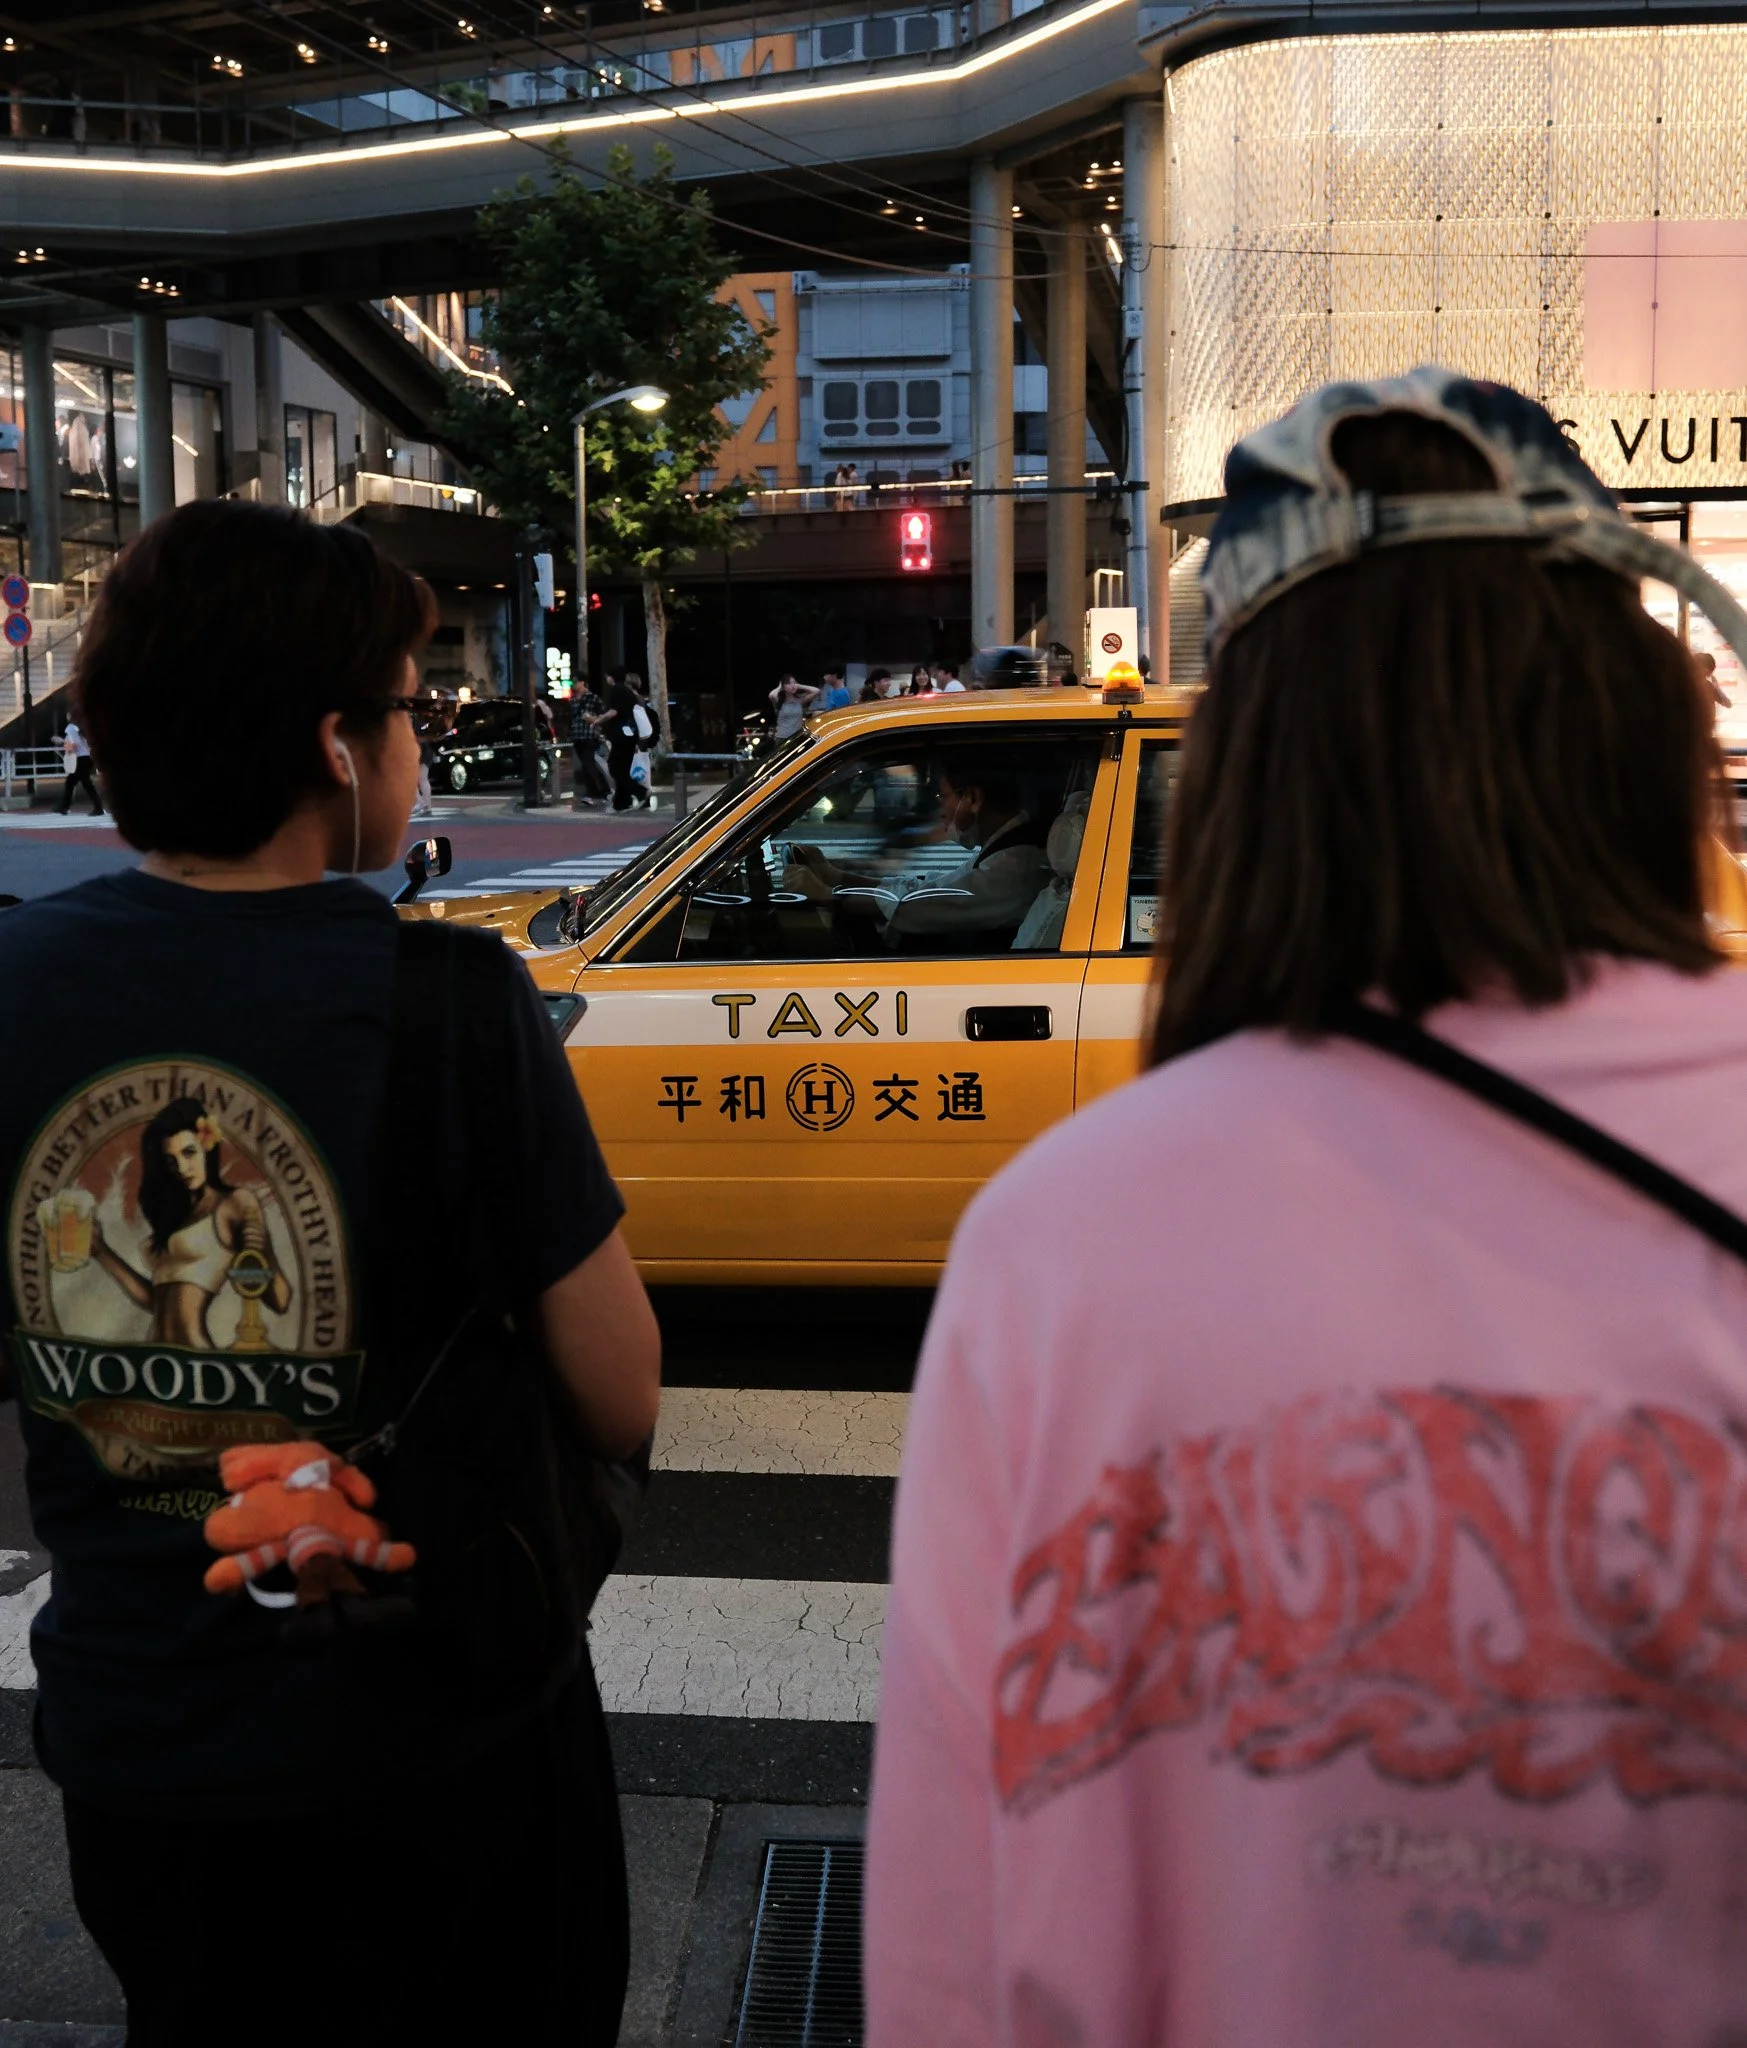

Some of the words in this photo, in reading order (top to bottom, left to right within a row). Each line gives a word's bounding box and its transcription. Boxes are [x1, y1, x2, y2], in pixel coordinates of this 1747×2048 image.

[712, 990, 908, 1039] TAXI
[20, 1181, 51, 1326] NOTHING
[41, 1085, 141, 1178] BETTER
[146, 1077, 235, 1113] THAN
[234, 1108, 256, 1132] A
[256, 1125, 331, 1249] FROTHY
[313, 1259, 337, 1347] HEAD
[27, 1339, 341, 1417] WOODY'S
[214, 1421, 280, 1440] BEER
